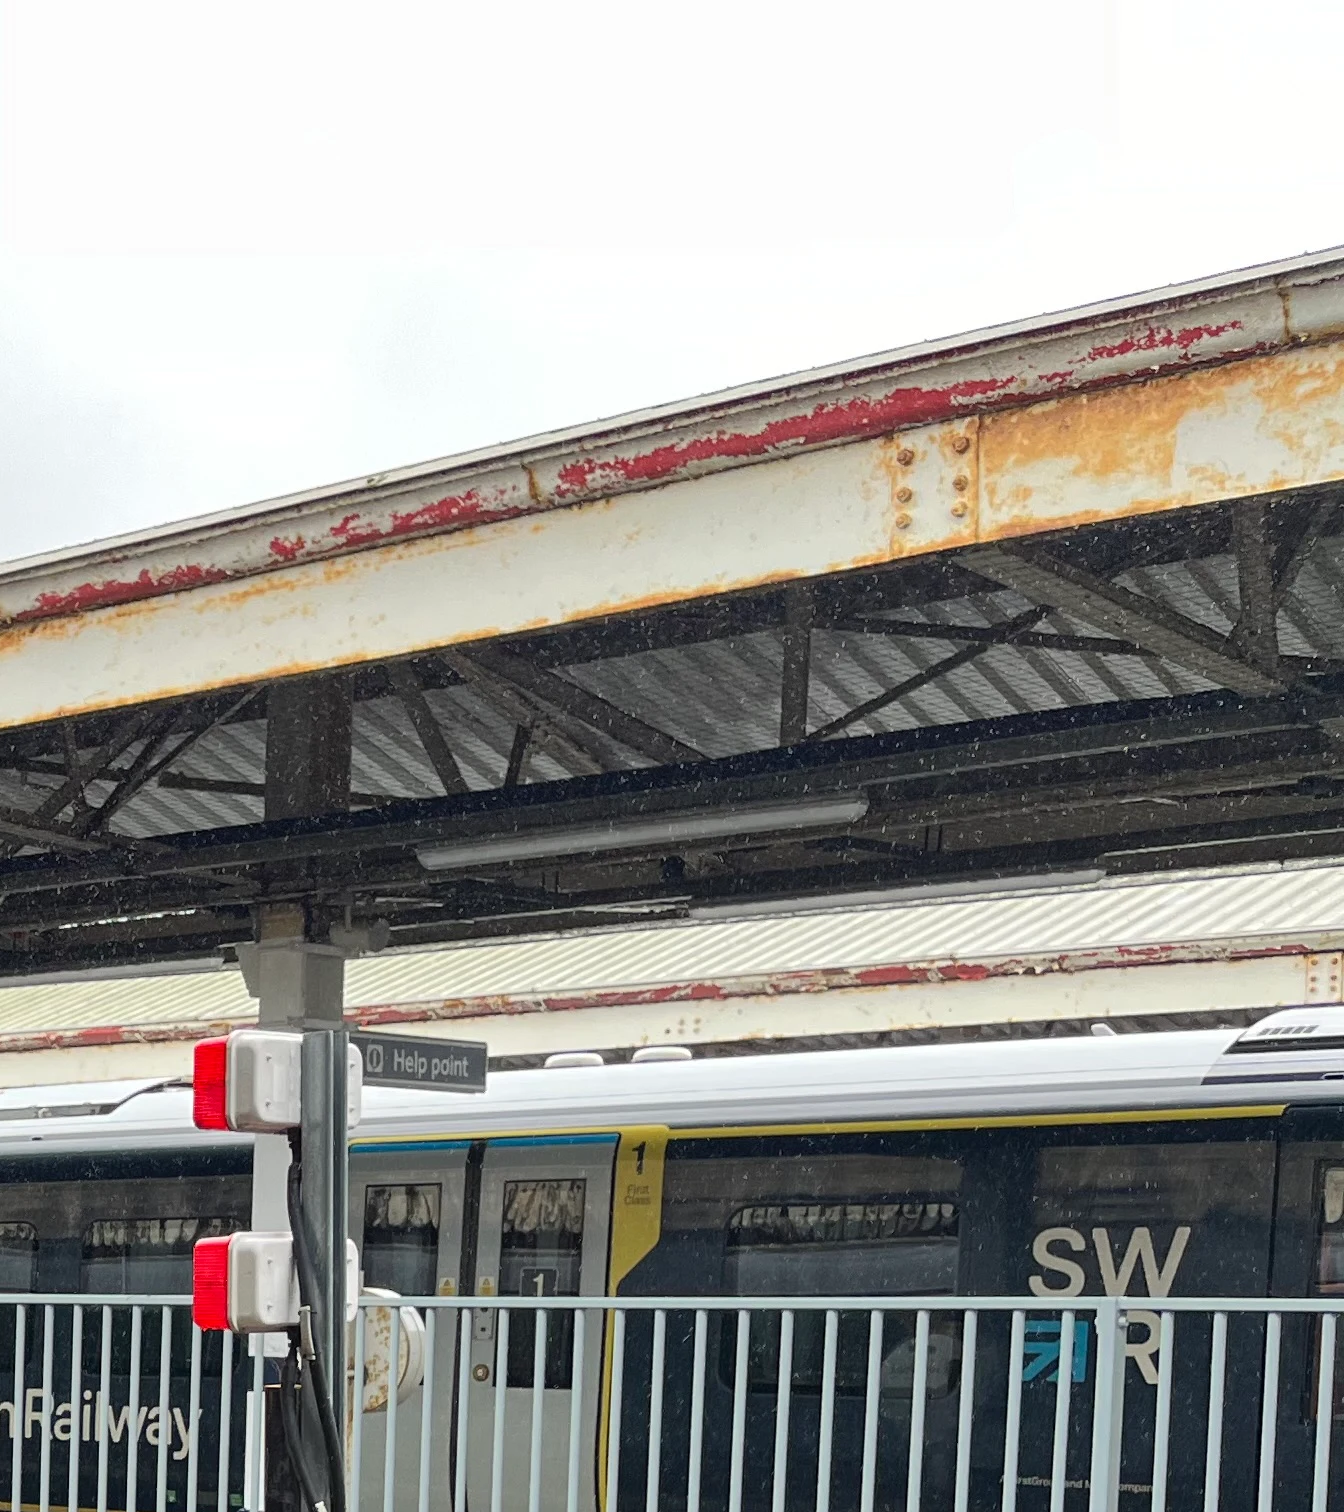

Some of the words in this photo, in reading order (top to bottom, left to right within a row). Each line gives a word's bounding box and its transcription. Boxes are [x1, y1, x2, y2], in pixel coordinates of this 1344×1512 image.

[393, 1048, 428, 1079] Help
[432, 1053, 469, 1080] point
[632, 1140, 646, 1175] 1
[1028, 1226, 1191, 1297] SW
